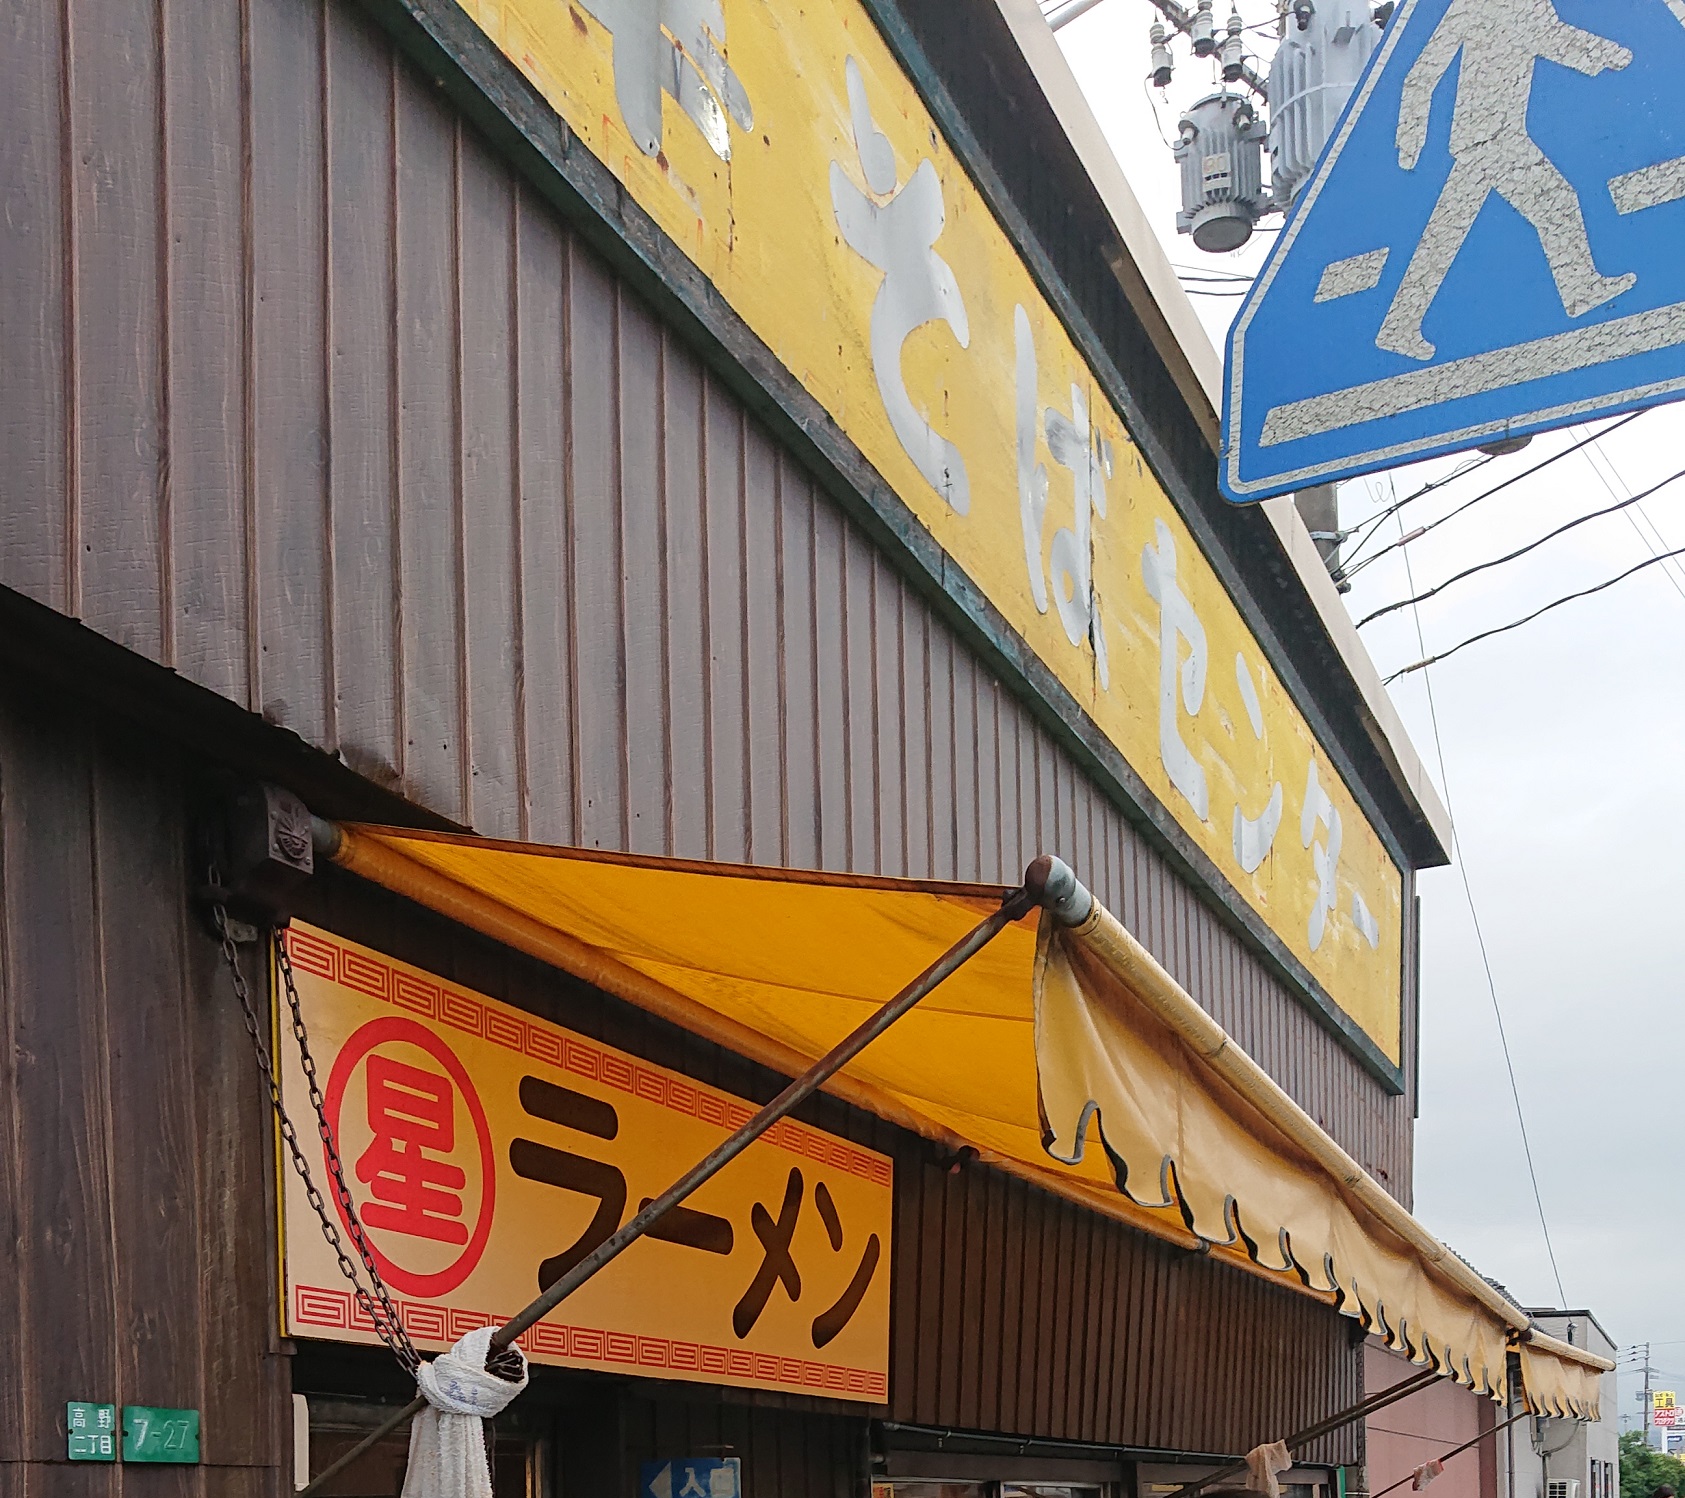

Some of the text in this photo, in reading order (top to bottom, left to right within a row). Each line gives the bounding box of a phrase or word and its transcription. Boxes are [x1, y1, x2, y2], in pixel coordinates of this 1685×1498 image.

[575, 0, 1380, 951] そばセンター
[72, 1407, 112, 1429] 高野
[74, 1434, 112, 1455] 二丁目
[132, 1418, 190, 1450] 7-27
[679, 1467, 735, 1498] 入口
